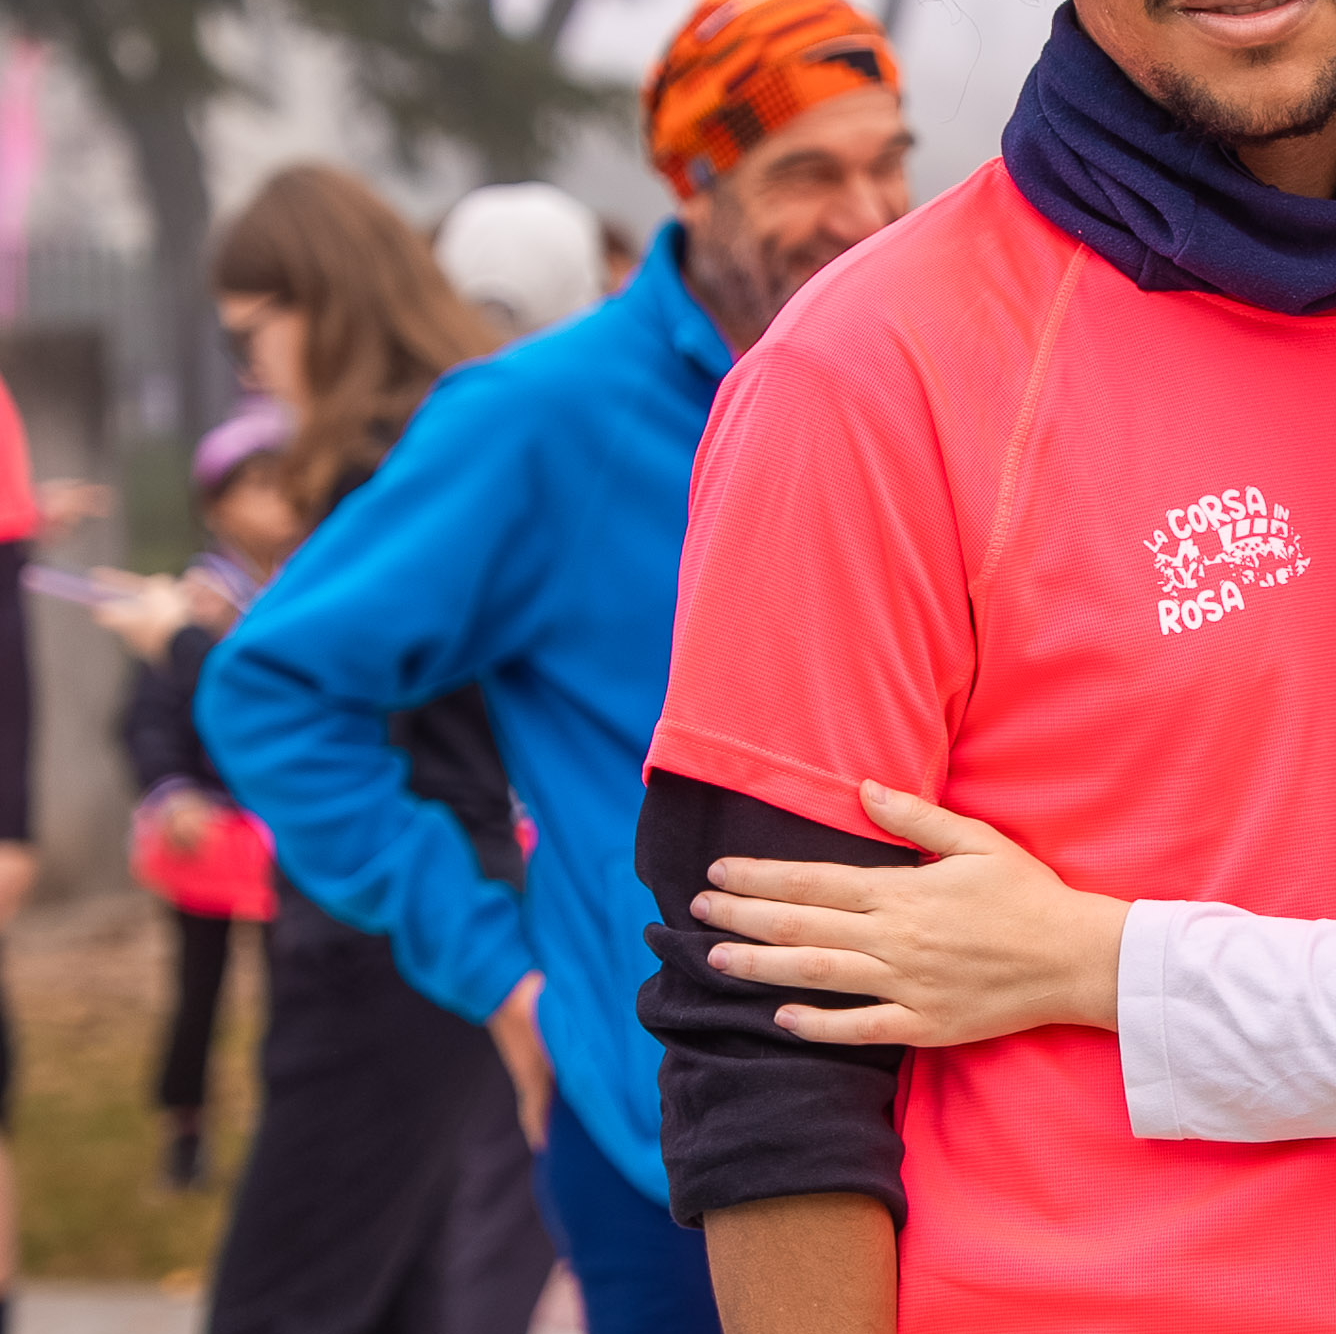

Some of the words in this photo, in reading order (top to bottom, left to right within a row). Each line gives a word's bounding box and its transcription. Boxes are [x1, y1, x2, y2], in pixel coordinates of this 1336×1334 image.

[1165, 485, 1268, 539] CORSA
[1273, 502, 1290, 521] IN
[1157, 580, 1246, 636] ROSA
